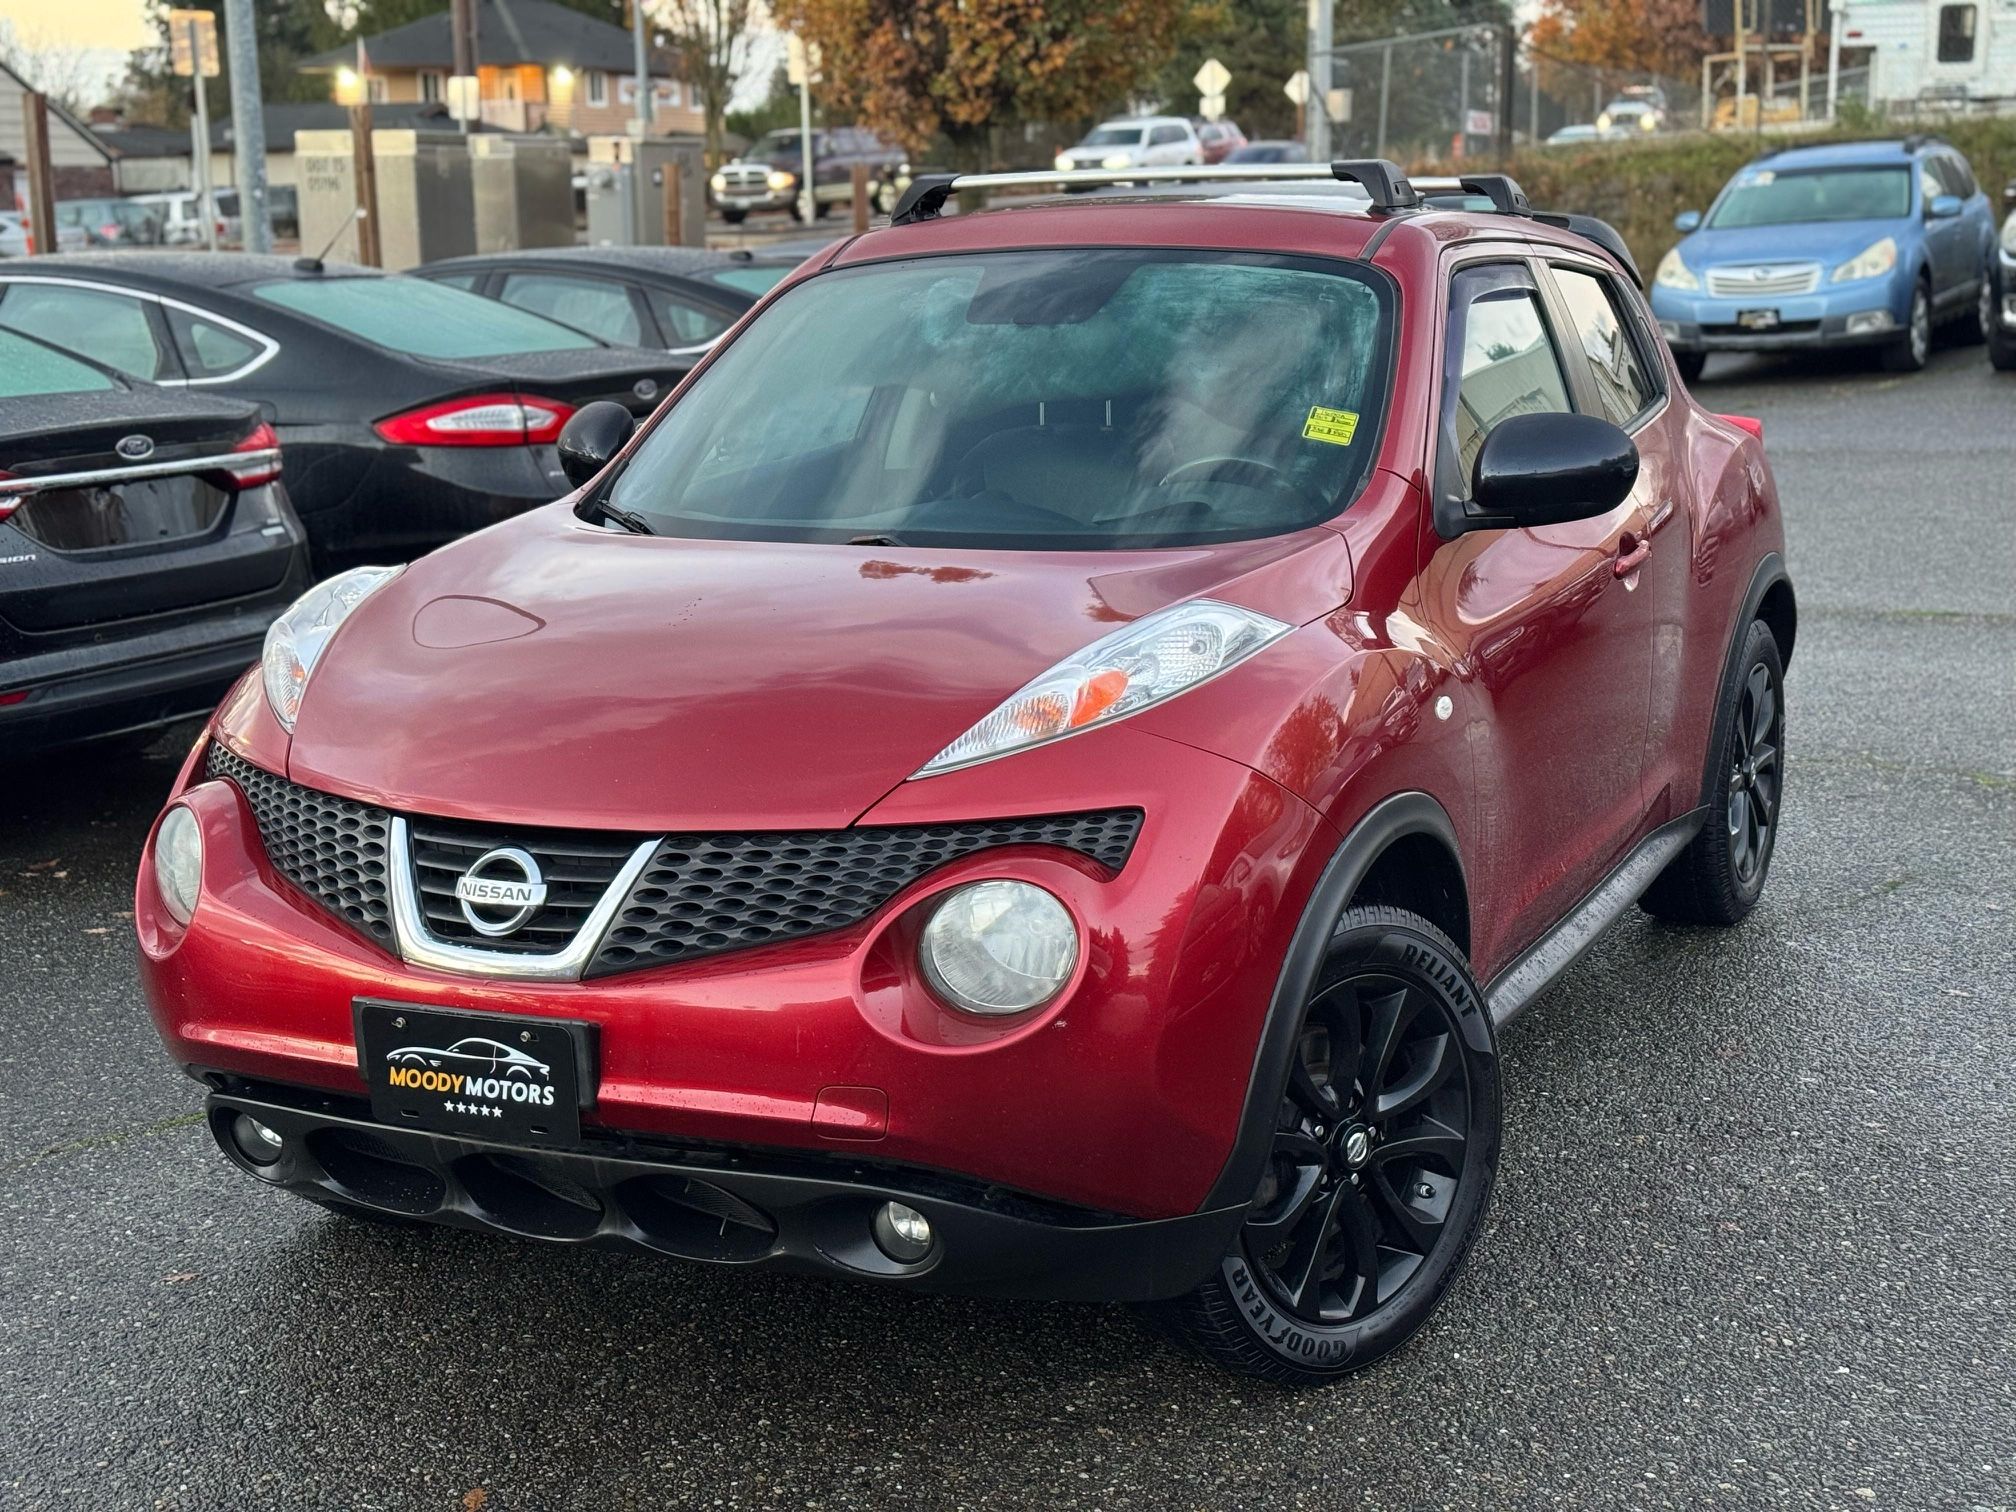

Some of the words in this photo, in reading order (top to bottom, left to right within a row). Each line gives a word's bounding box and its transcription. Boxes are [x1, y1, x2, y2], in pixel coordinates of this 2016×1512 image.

[460, 882, 532, 902] NISSAN
[1399, 943, 1478, 1018] RELIANT
[1231, 1264, 1347, 1360] GOODYEAR
